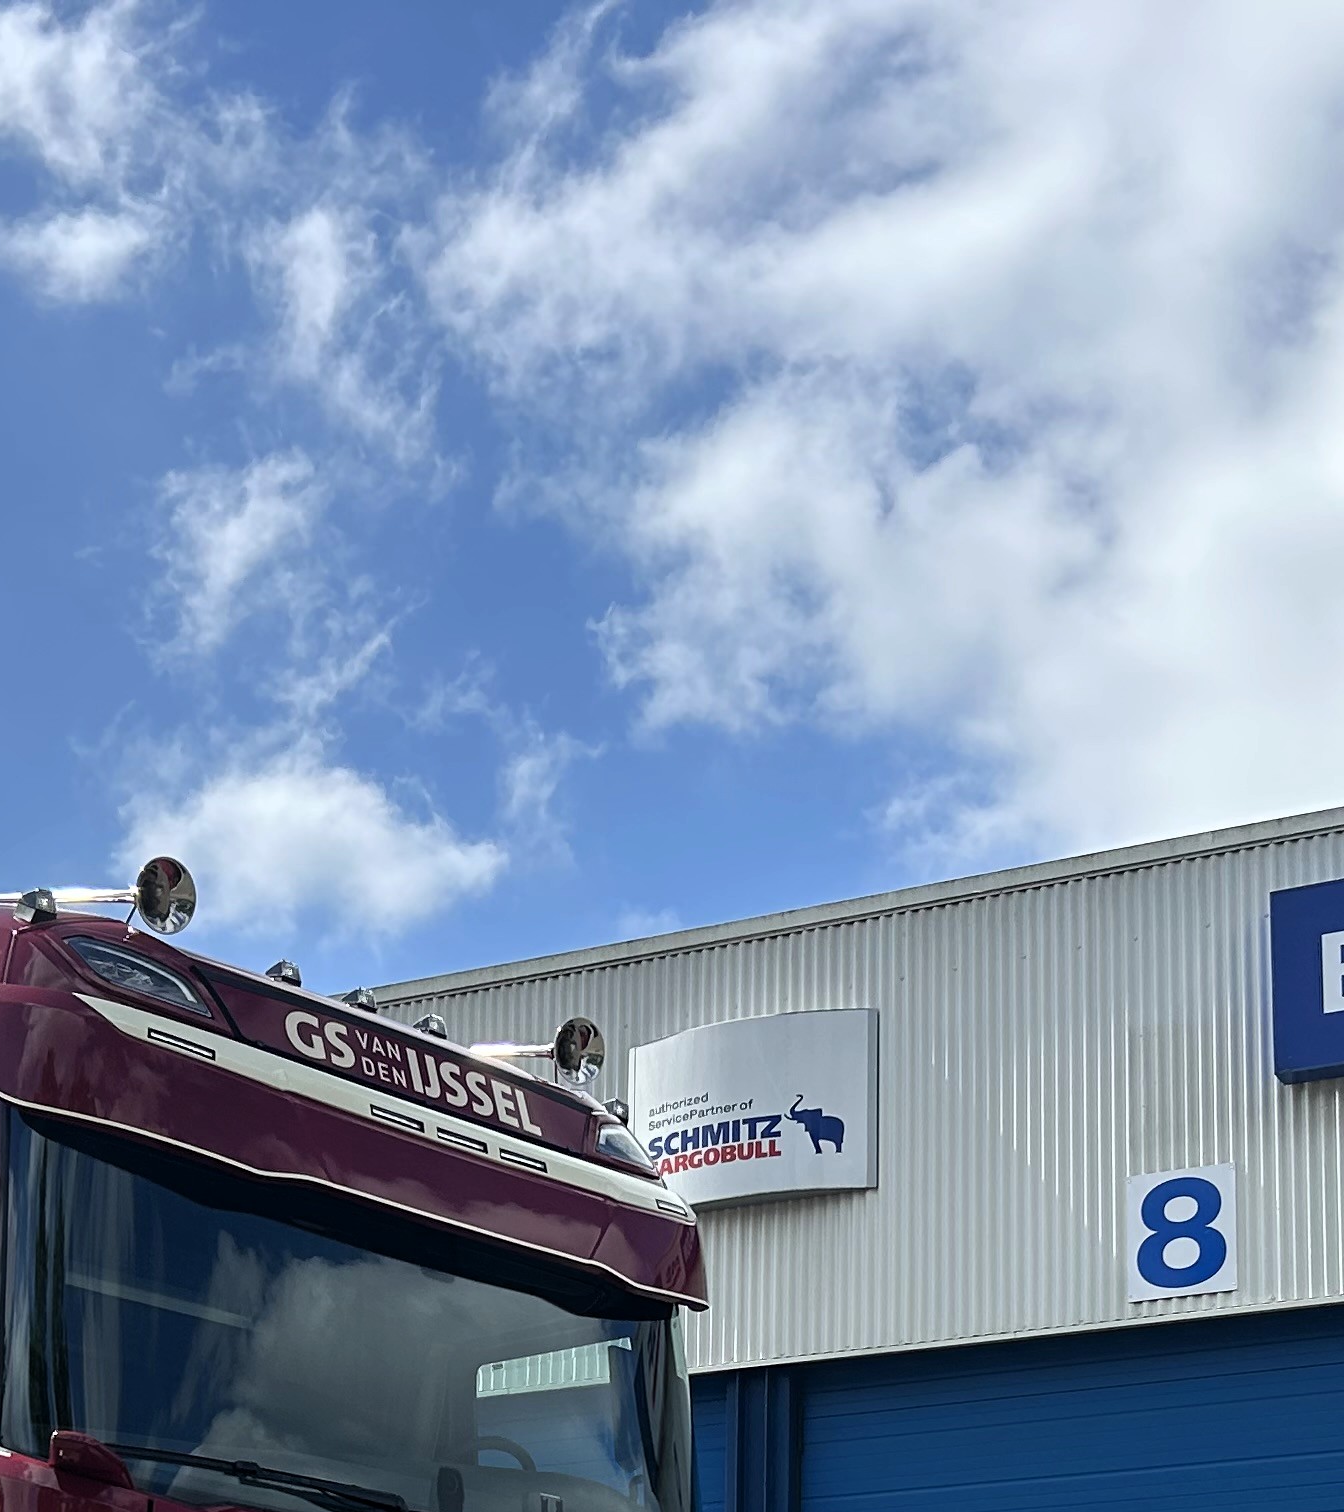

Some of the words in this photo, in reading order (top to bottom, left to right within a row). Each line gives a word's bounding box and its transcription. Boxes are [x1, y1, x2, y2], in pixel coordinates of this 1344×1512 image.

[284, 1010, 356, 1069] GS
[355, 1029, 402, 1063] VAN
[361, 1056, 408, 1089] DEN
[405, 1047, 543, 1137] IJSSEL
[739, 1098, 754, 1111] of
[648, 1114, 782, 1160] SCHMITZ
[654, 1139, 782, 1177] ARGOBULL
[1136, 1176, 1227, 1289] 8
